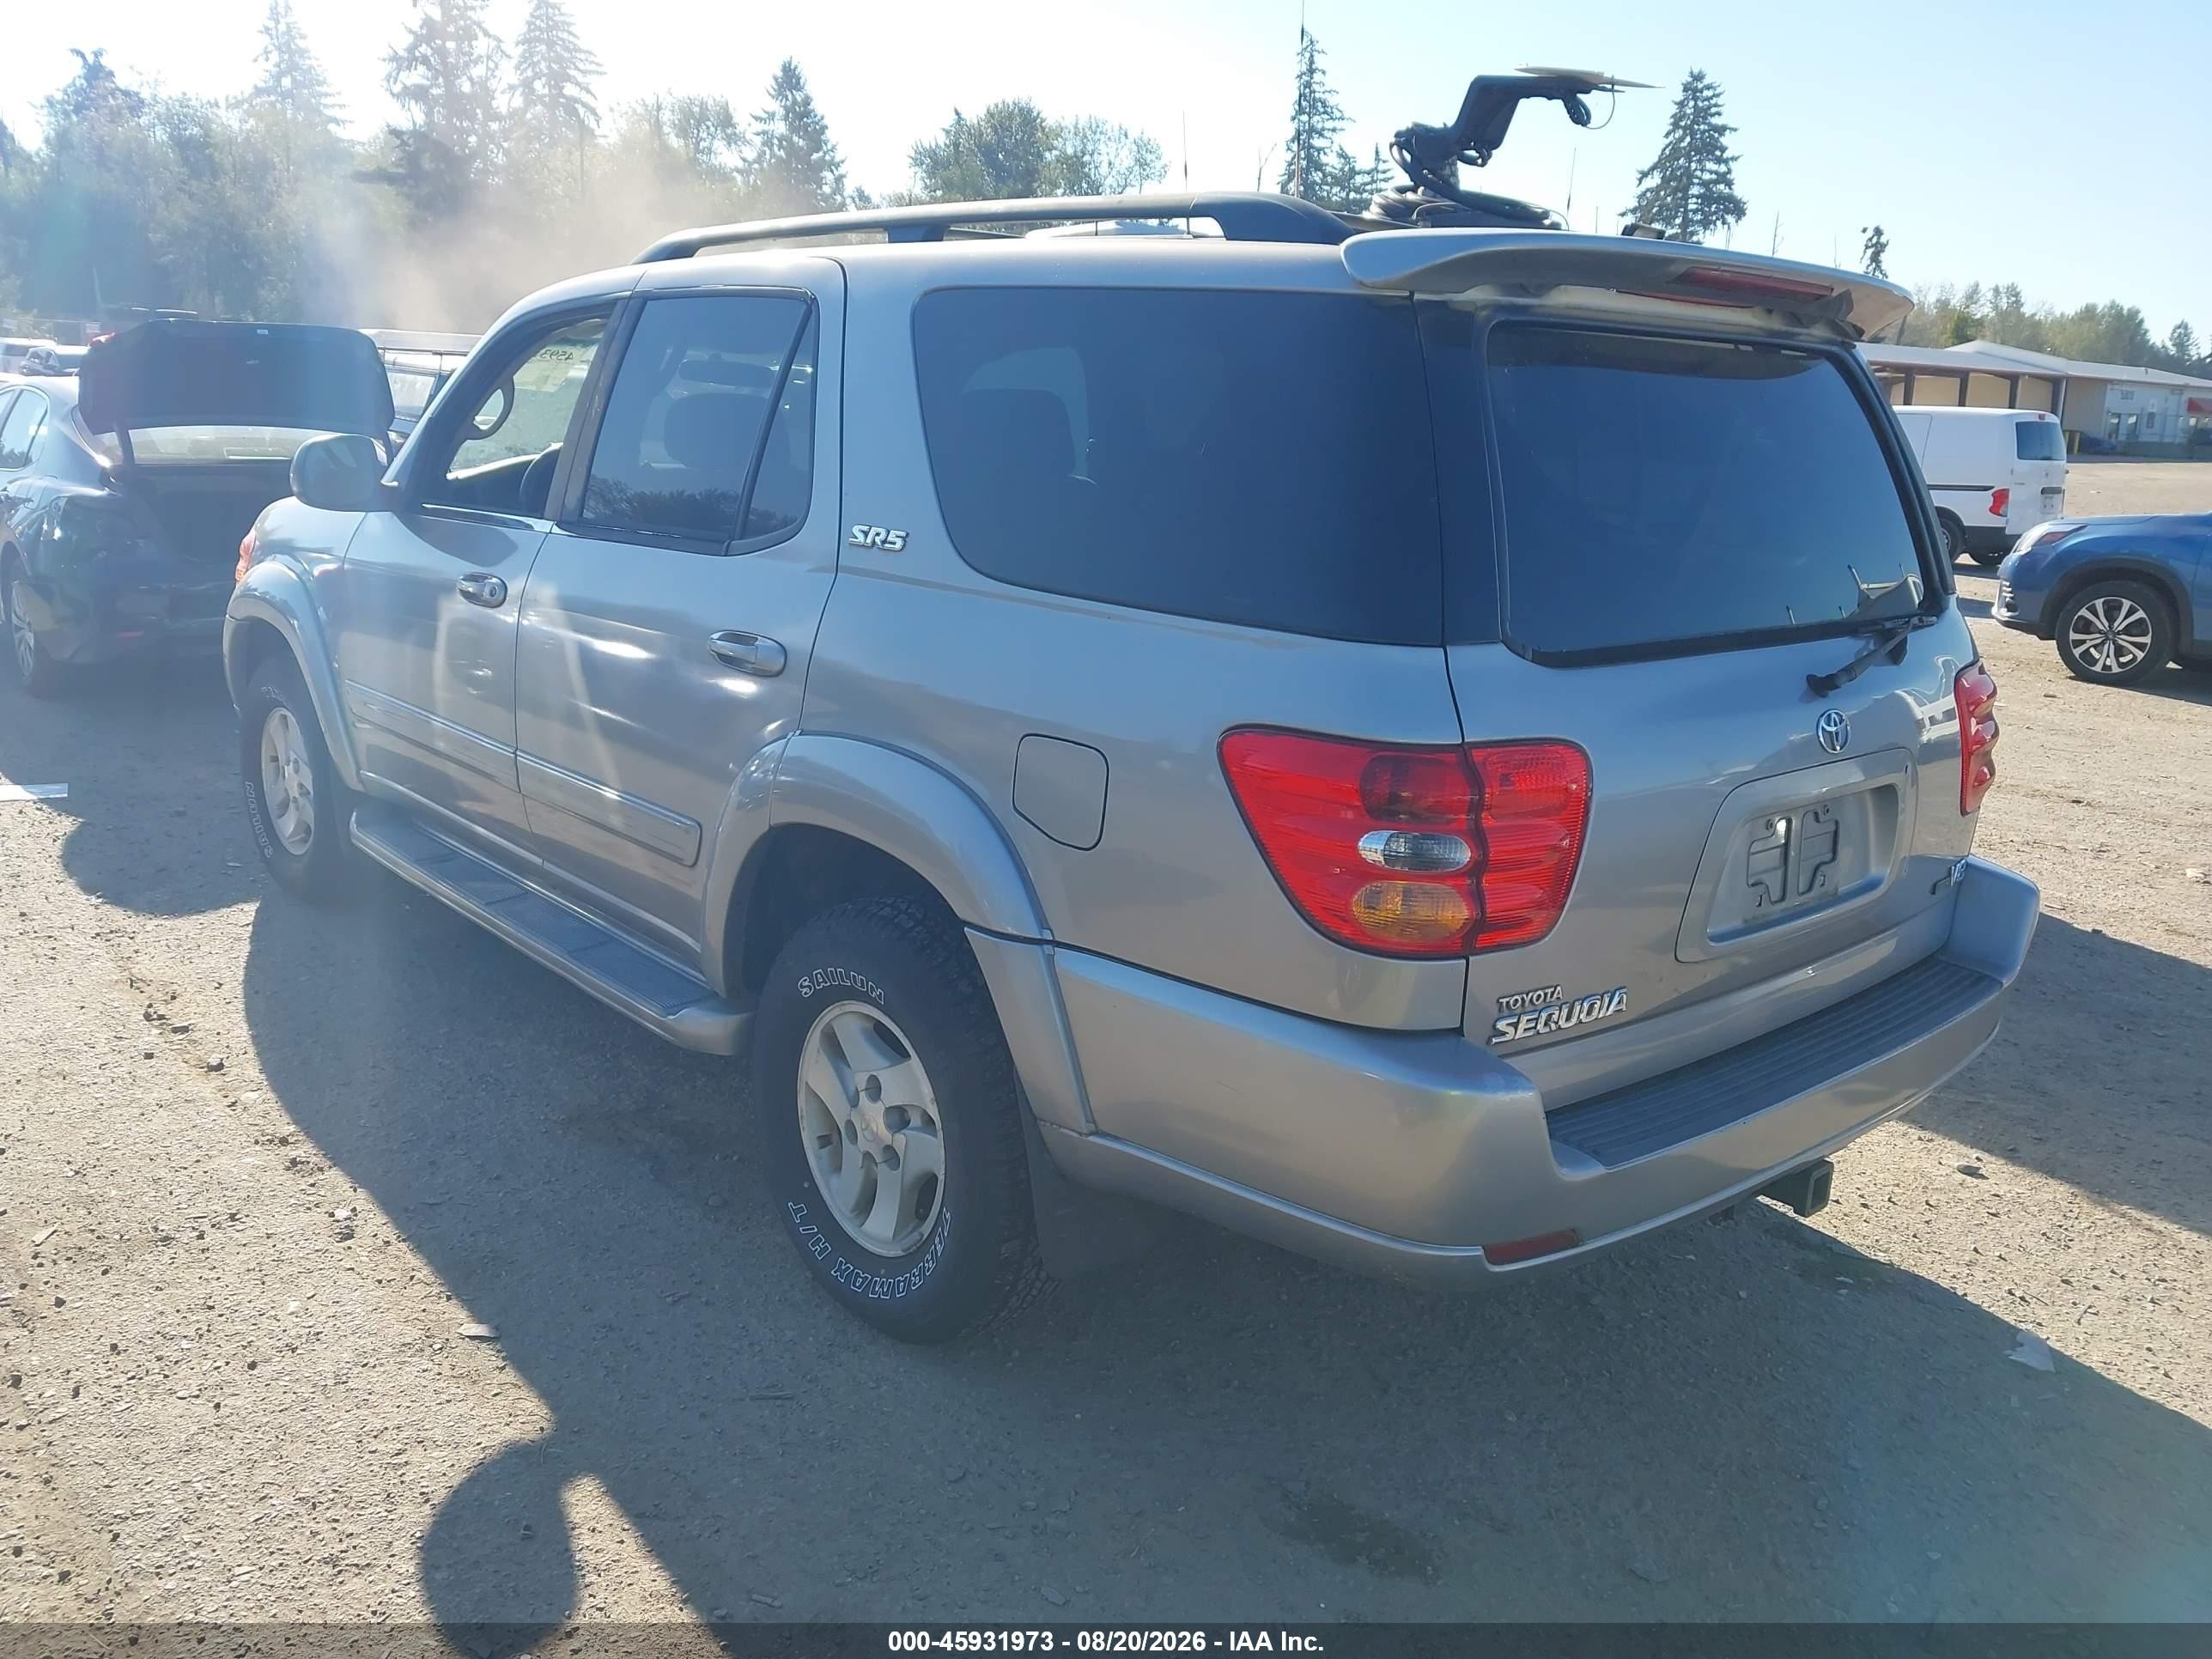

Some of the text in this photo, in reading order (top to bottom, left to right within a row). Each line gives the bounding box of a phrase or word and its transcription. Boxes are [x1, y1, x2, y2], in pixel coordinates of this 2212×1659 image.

[848, 524, 908, 551] SR5
[797, 967, 884, 1006] SAILUN
[1497, 984, 1564, 1012] TOYOTA
[1489, 987, 1628, 1045] SEQUOIA
[787, 1201, 951, 1299] TERRAMAX H/T
